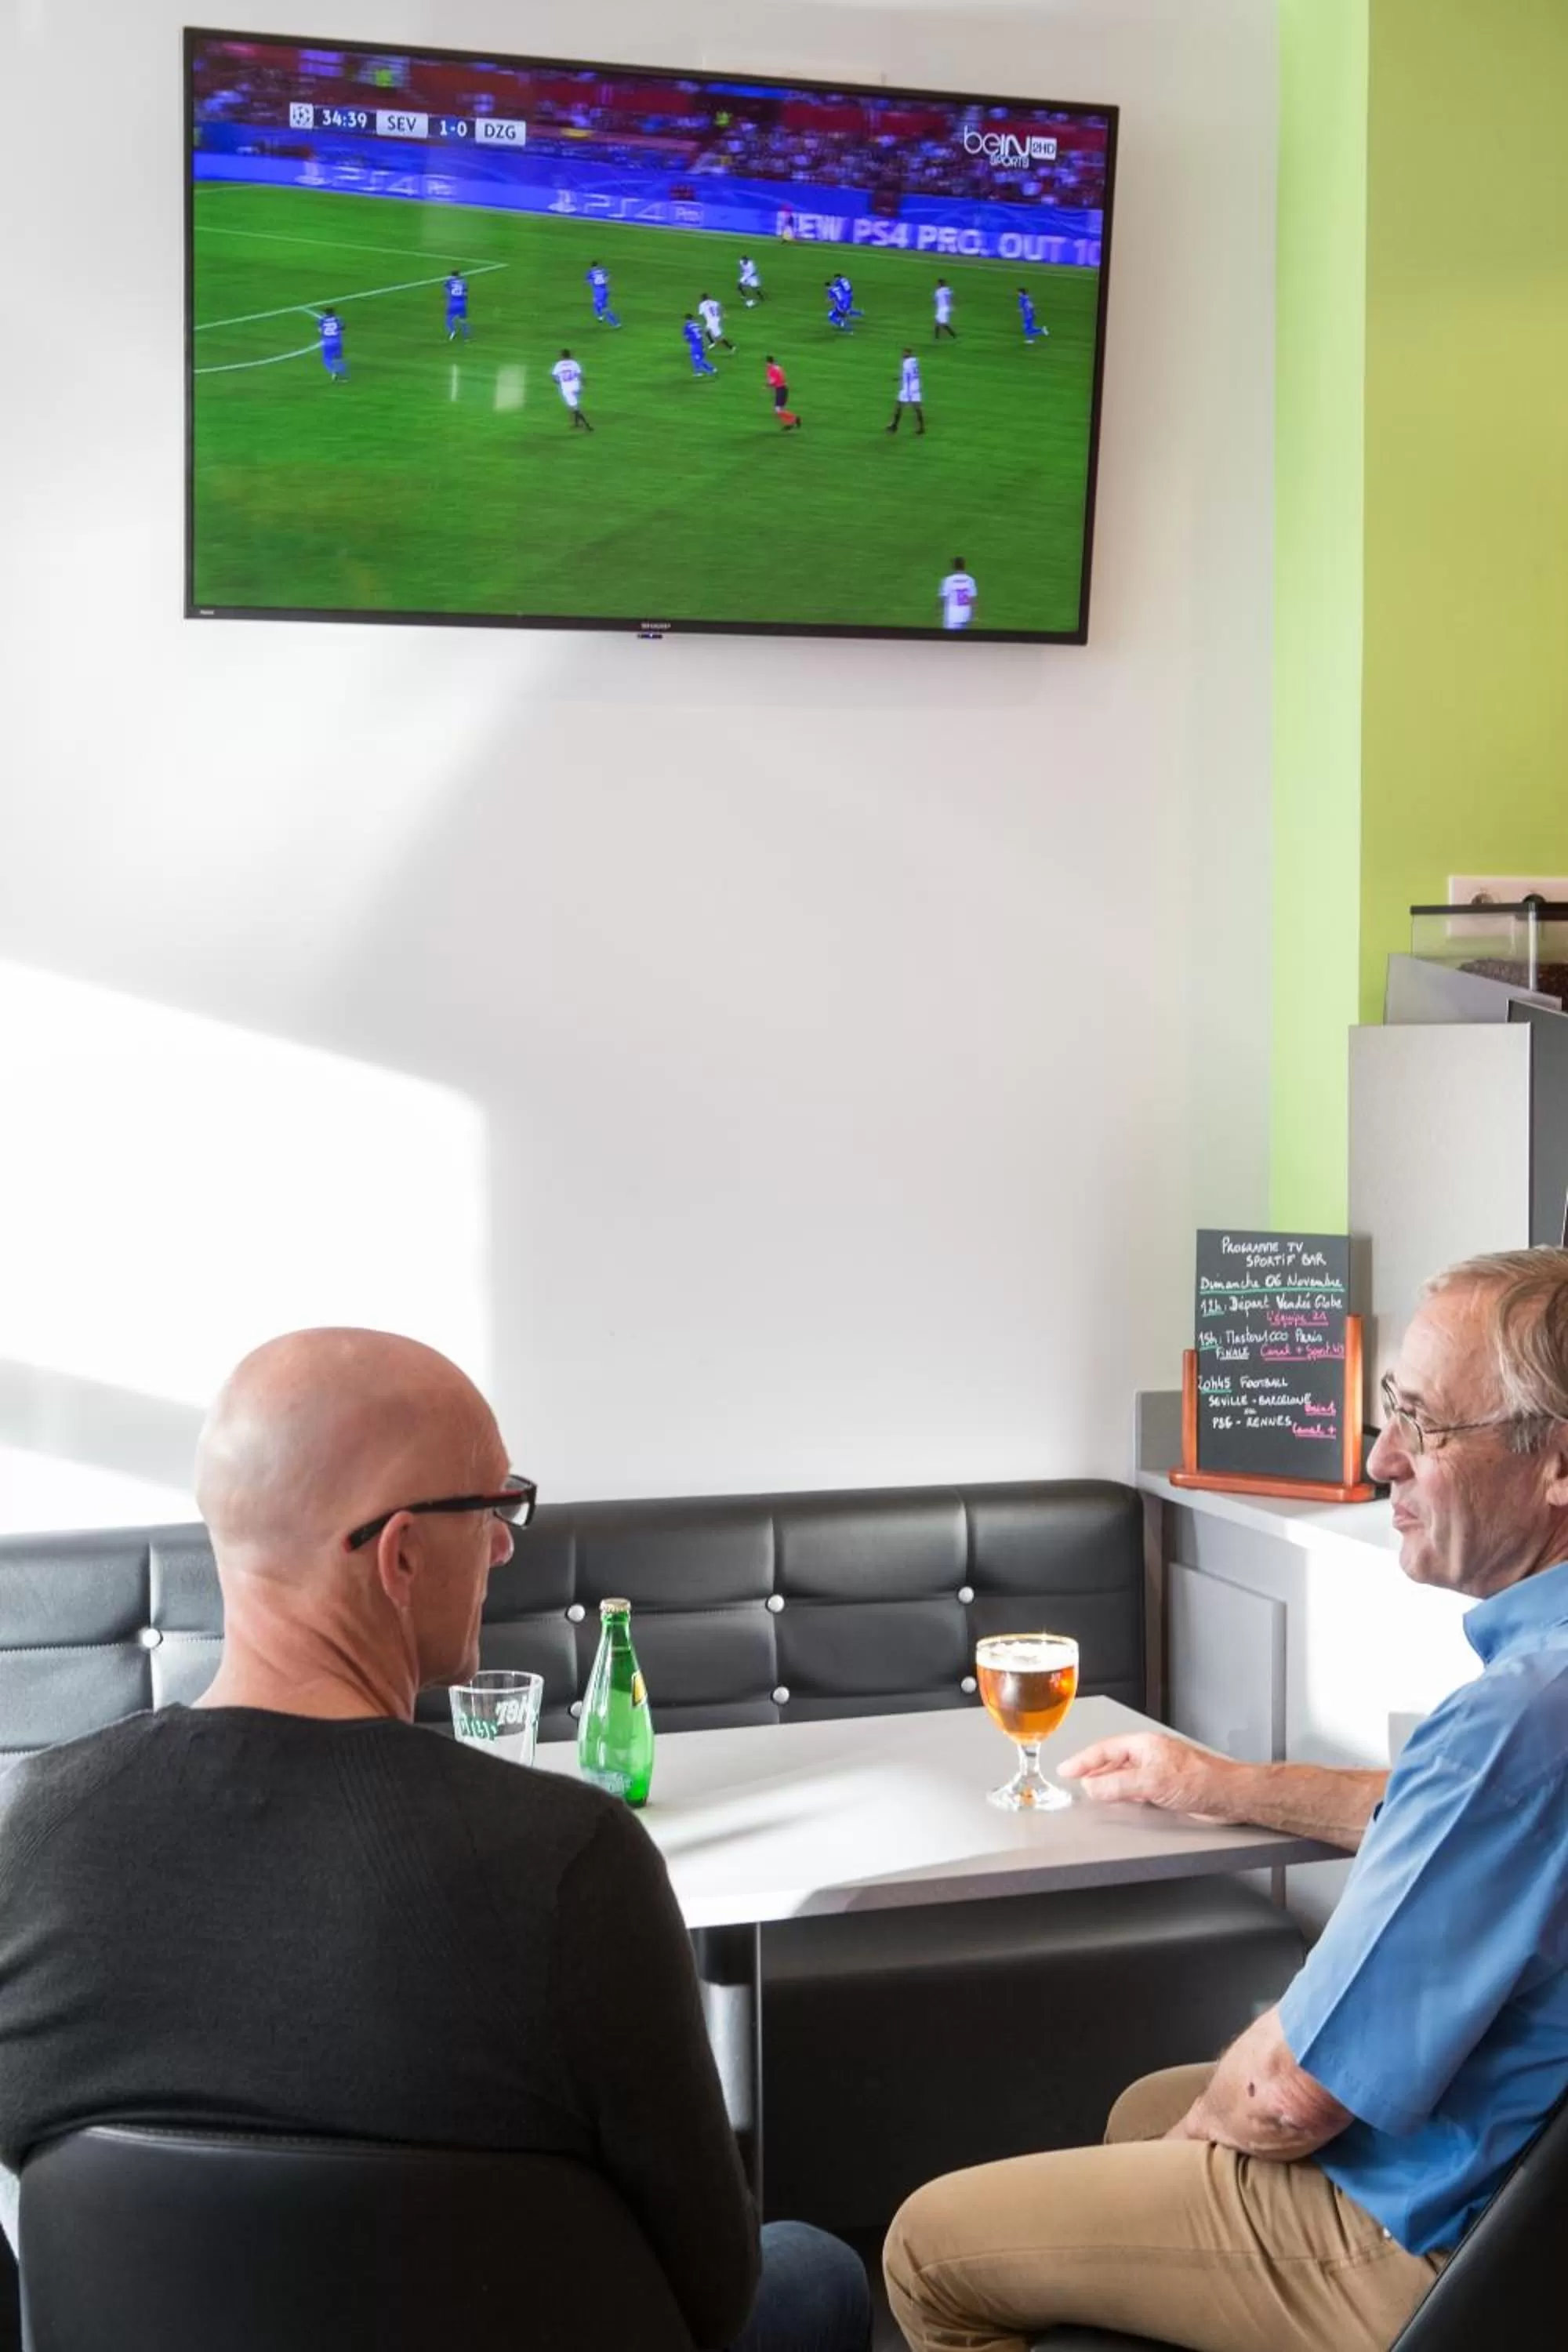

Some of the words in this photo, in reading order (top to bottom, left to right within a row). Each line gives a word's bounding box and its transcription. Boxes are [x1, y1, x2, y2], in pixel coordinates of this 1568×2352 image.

[321, 109, 368, 129] 34:39
[387, 115, 416, 132] SEV
[439, 121, 467, 137] 1-0
[484, 124, 516, 140] DZG
[853, 218, 909, 249] PS4
[998, 232, 1066, 263] OUT
[1287, 1241, 1304, 1253] TV
[1301, 1252, 1327, 1266] BAR
[1265, 1273, 1282, 1287] 06
